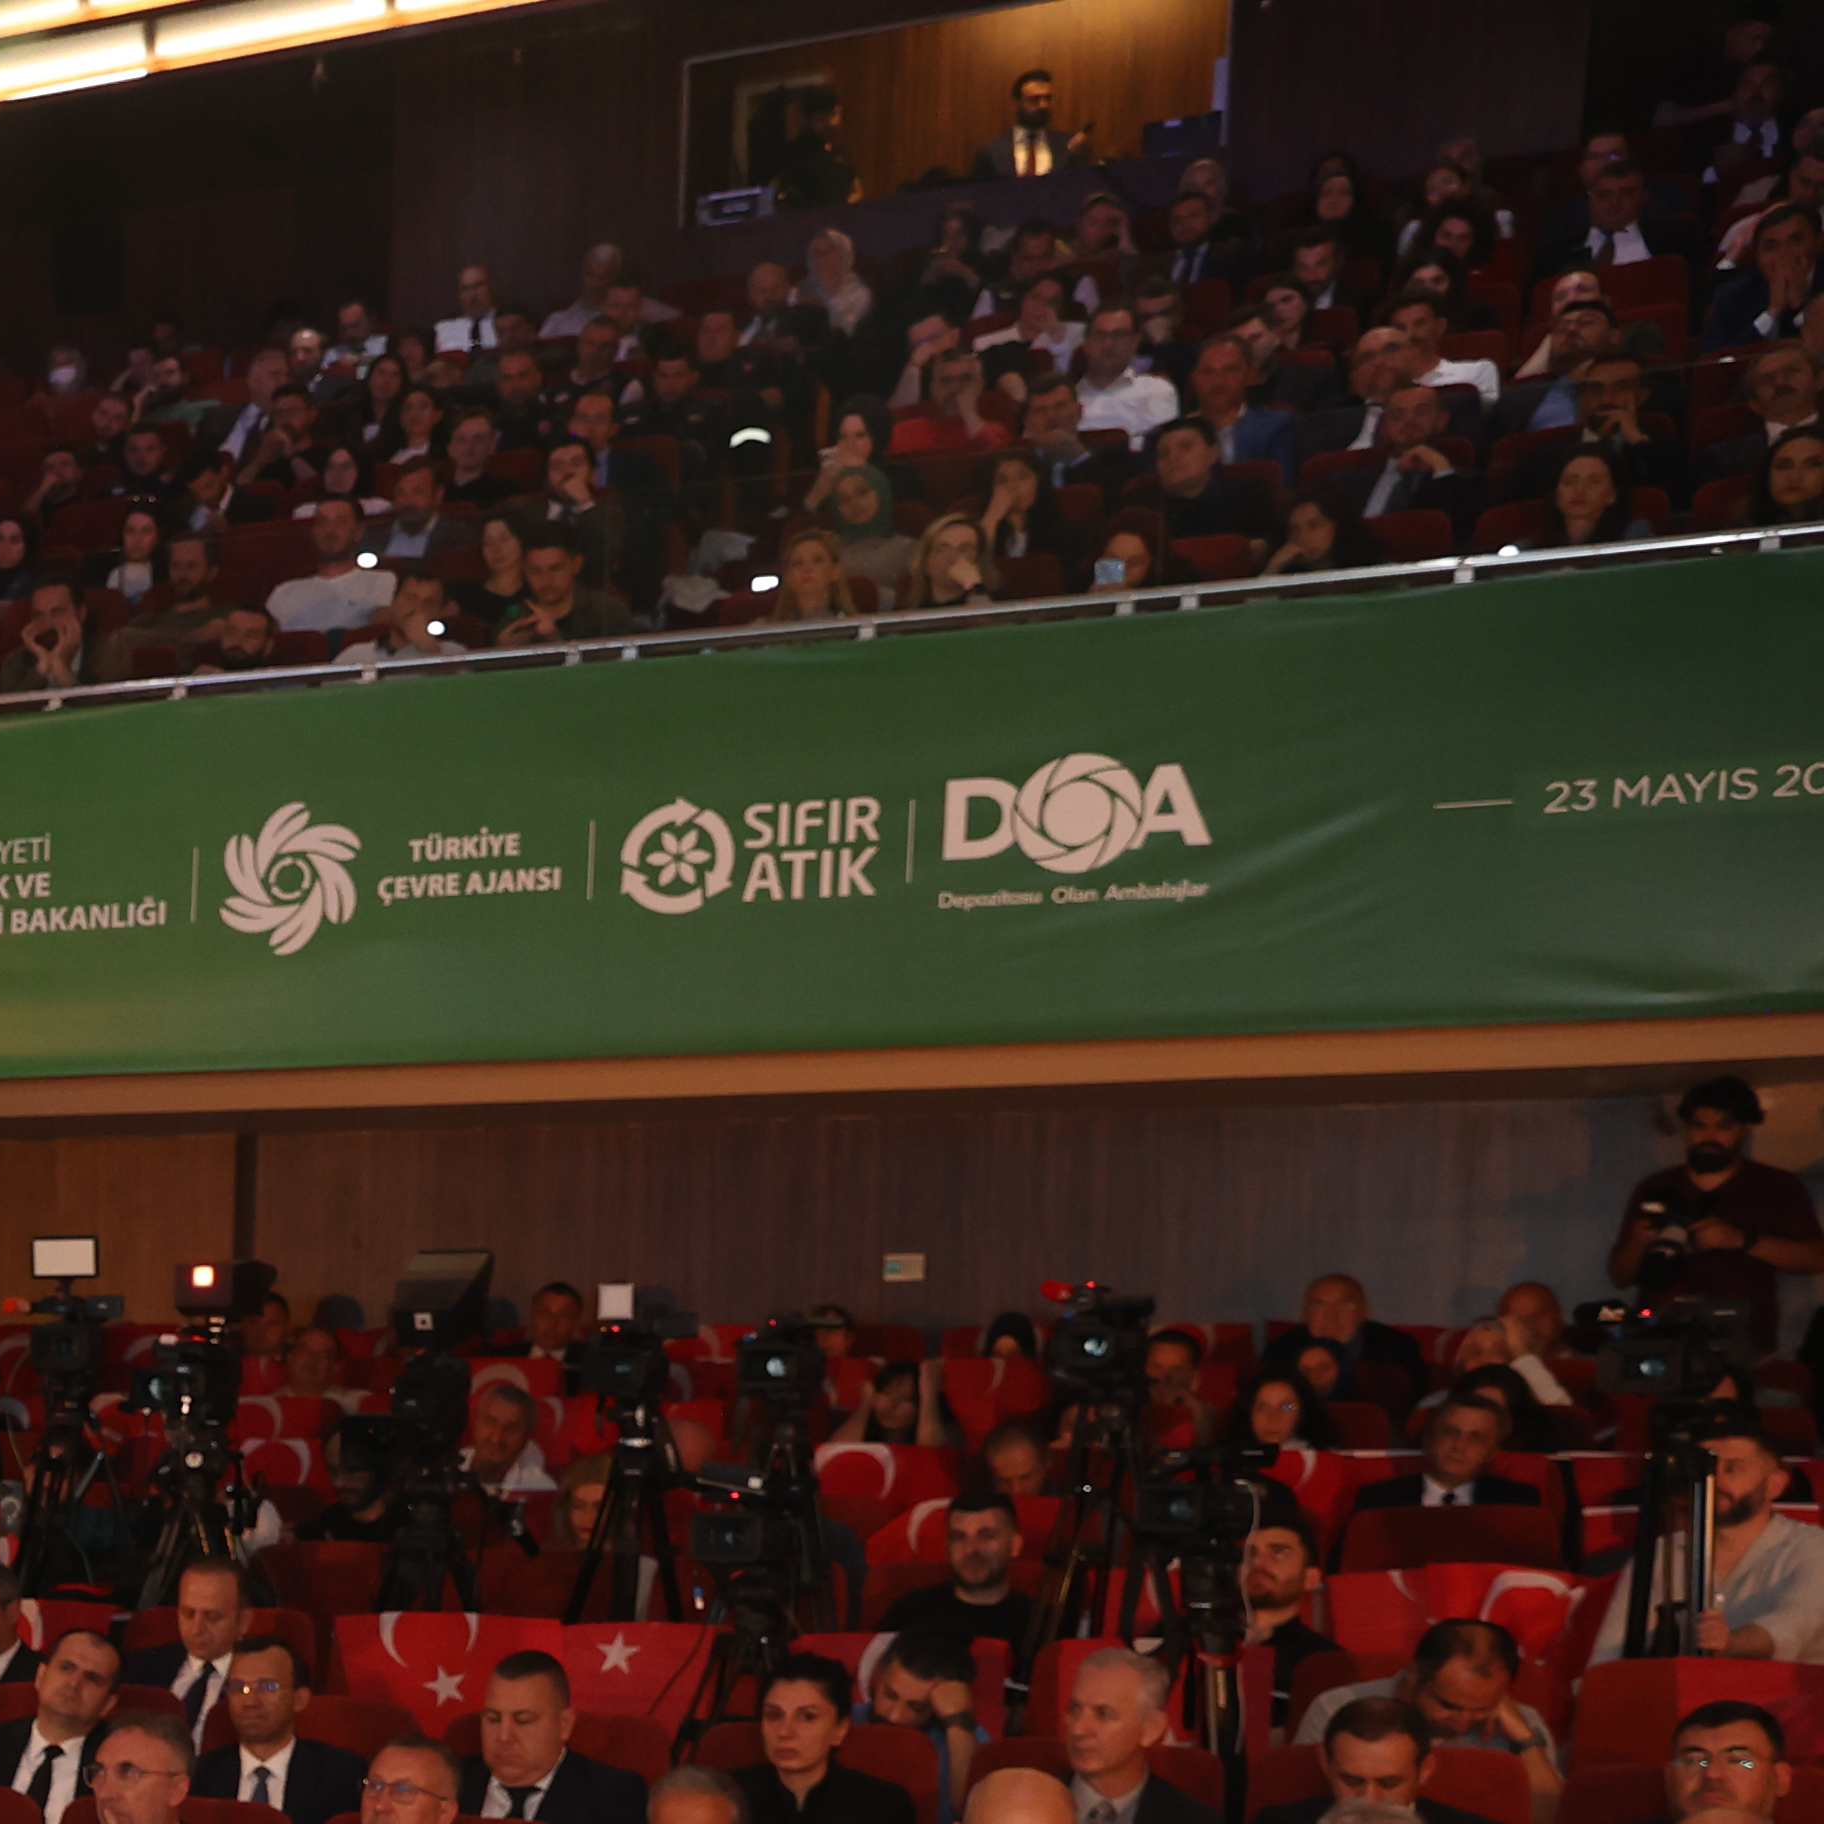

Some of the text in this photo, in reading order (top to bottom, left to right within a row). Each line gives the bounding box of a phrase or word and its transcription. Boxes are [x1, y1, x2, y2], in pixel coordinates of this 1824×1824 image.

[1543, 778, 1598, 814] 23
[1612, 766, 1759, 809] MAYIS
[742, 796, 882, 849] SIFIR
[408, 826, 521, 863] TÜRKİYE
[15, 872, 51, 898] VE
[378, 866, 561, 905] ÇEVRE AJANSI
[741, 845, 879, 902] ATIK
[1051, 885, 1099, 904] Olan
[10, 895, 167, 934] BAKANLIĞI
